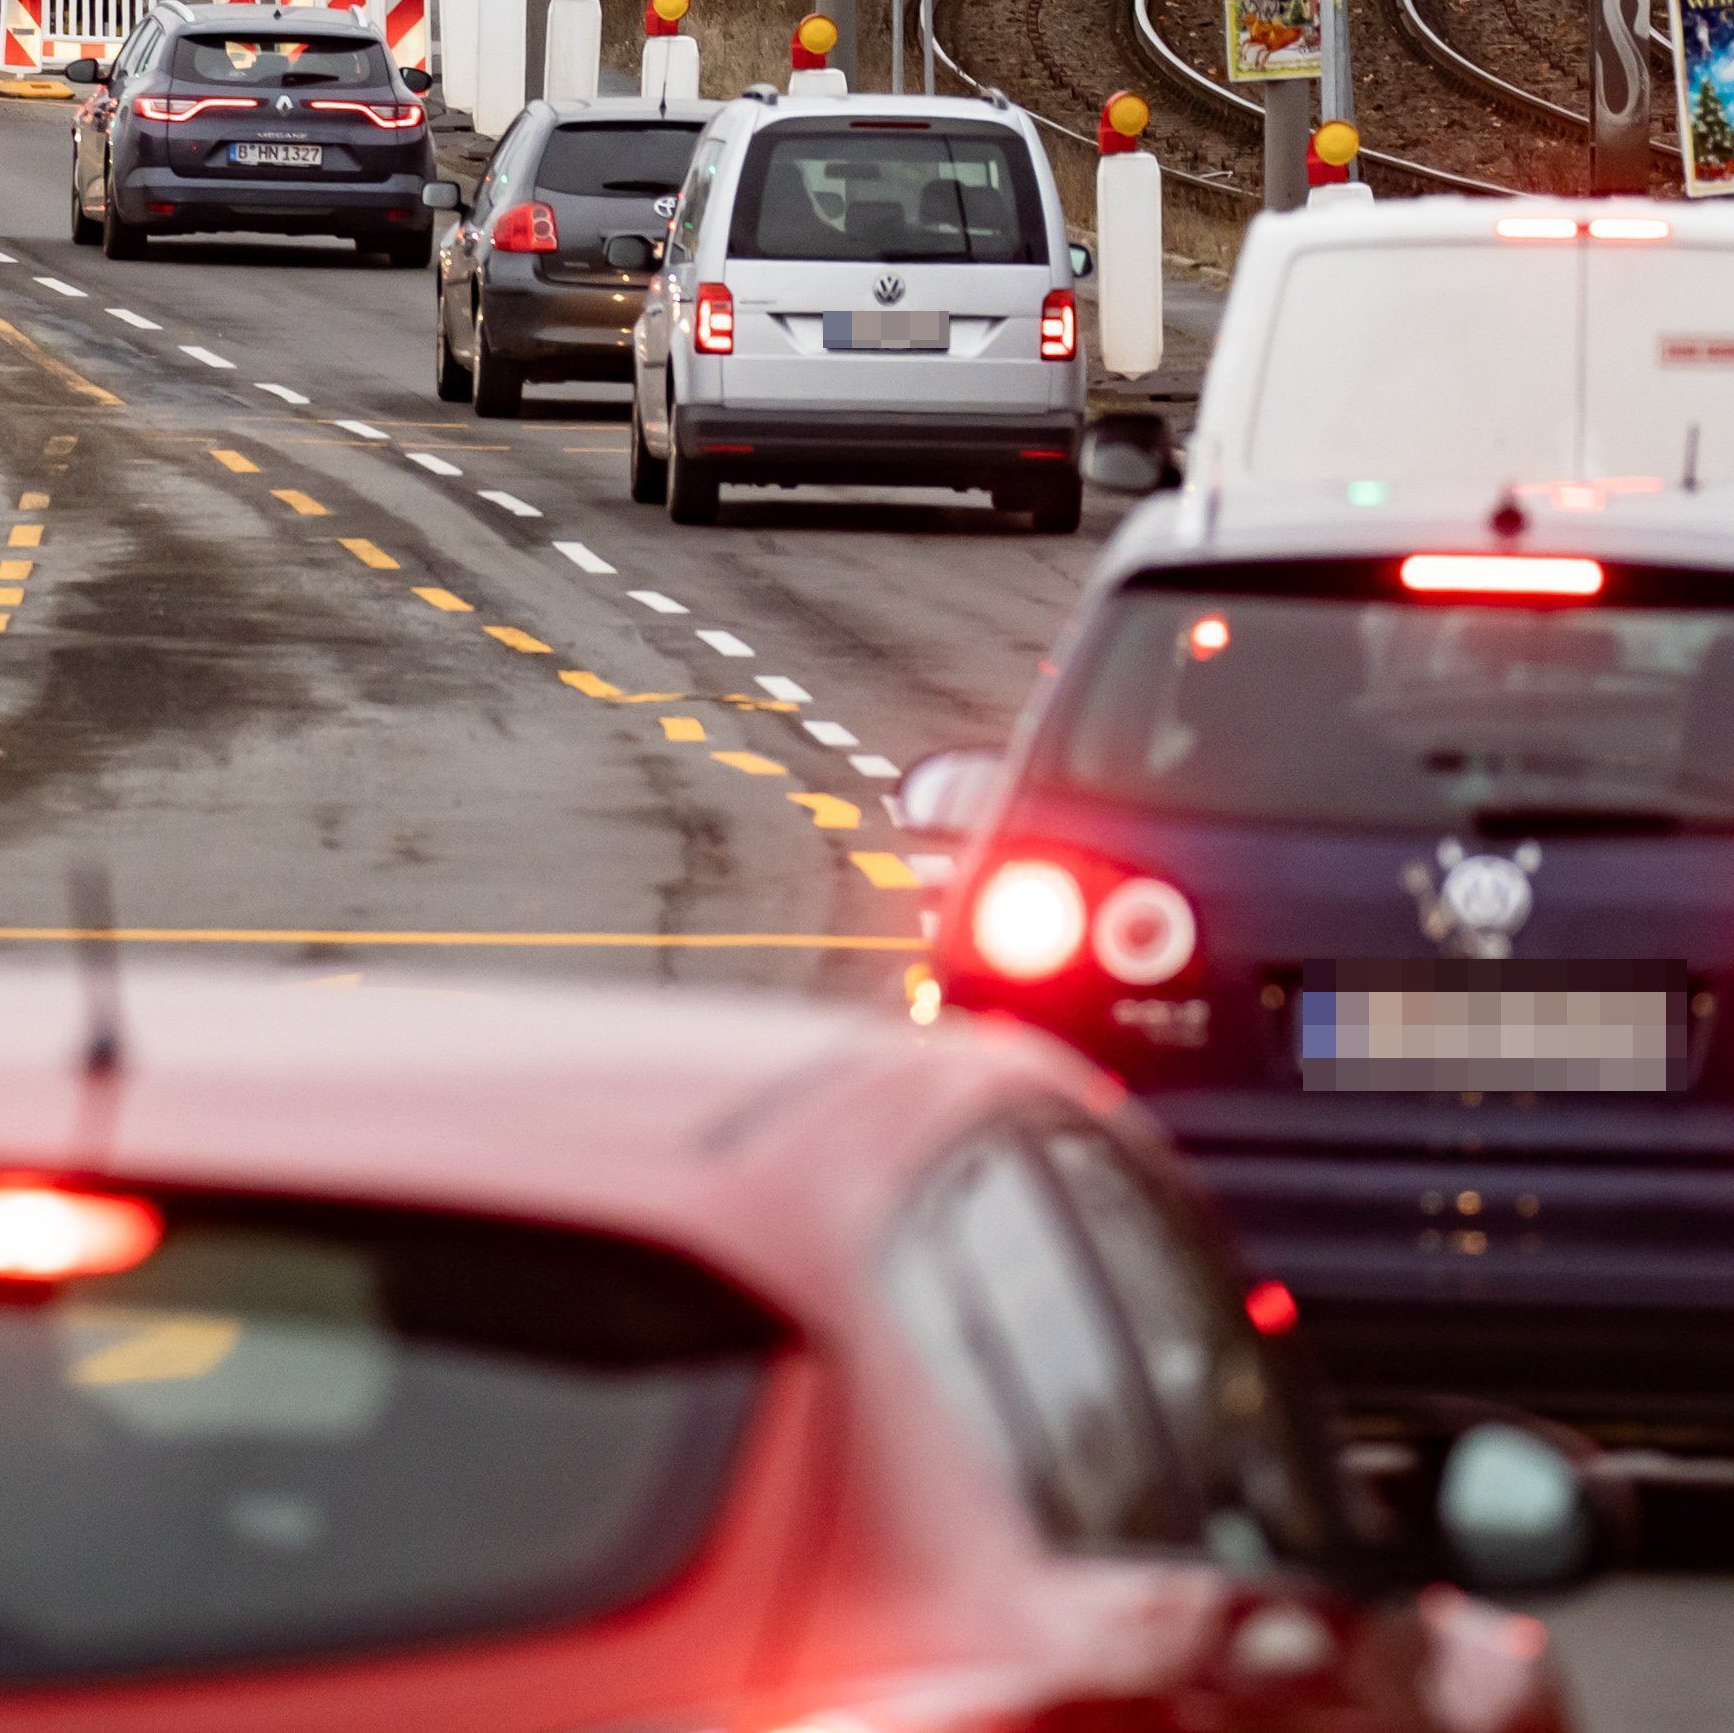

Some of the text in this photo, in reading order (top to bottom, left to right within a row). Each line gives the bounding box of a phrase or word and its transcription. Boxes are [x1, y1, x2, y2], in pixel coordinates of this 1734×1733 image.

[238, 145, 320, 162] B HN 1327
